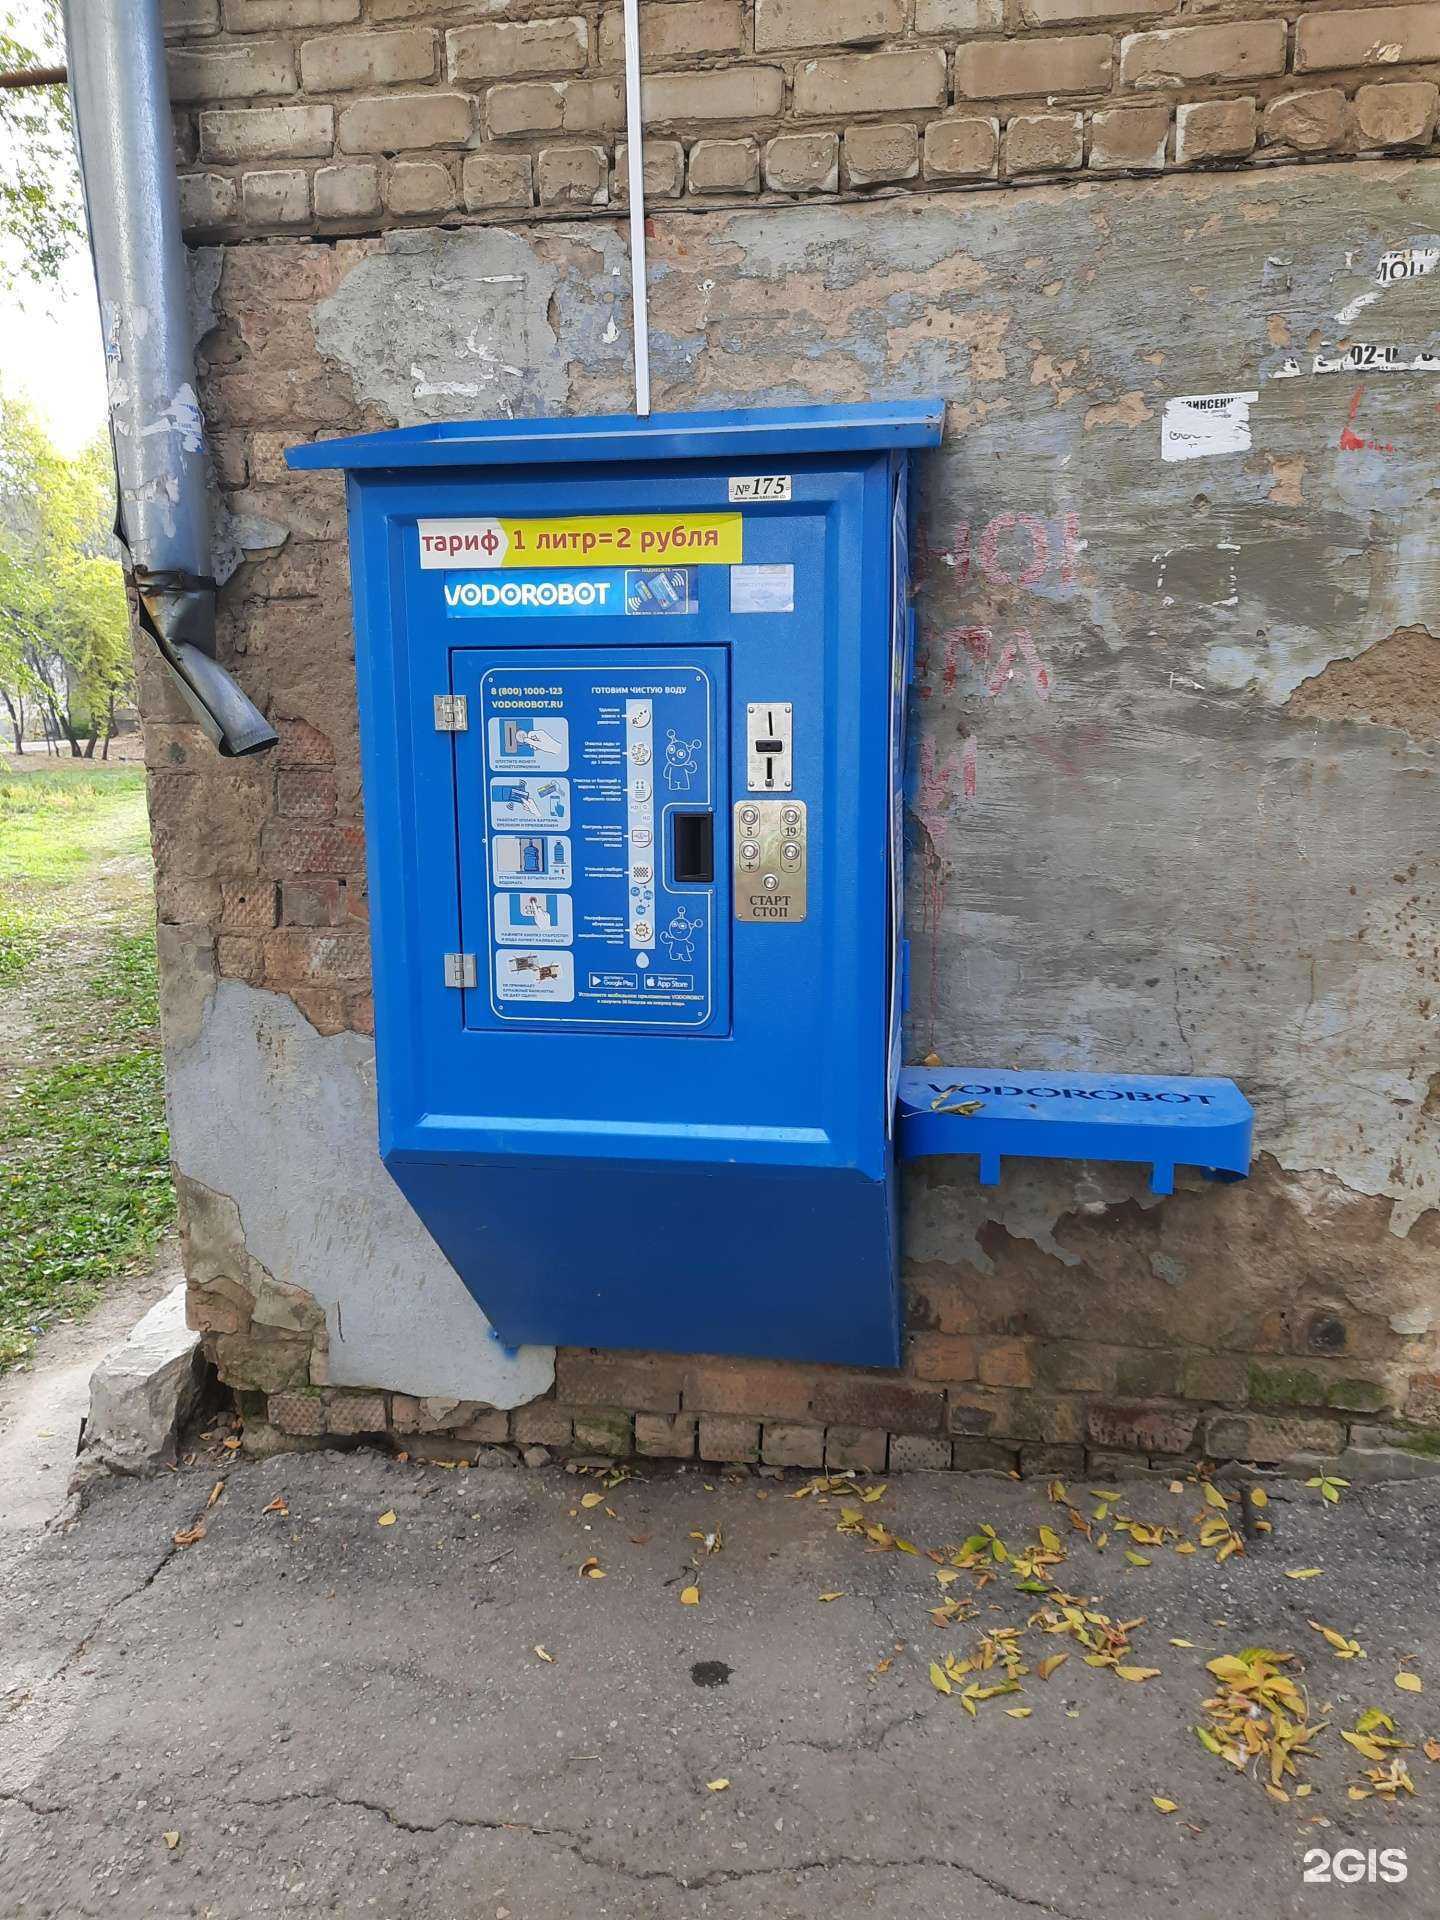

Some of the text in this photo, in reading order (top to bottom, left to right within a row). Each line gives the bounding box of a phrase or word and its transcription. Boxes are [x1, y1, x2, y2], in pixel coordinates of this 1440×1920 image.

[752, 476, 786, 495] 175
[422, 525, 719, 556] тариф 1 литр=2 рубля
[443, 582, 611, 606] VODOROBOT
[591, 686, 687, 695] ГОТОВИМ ЧИСТУЮ ВОДУ
[491, 700, 564, 709] VODOROBOT.RU
[746, 826, 753, 837] 5
[785, 826, 797, 837] 19
[749, 895, 791, 906] СТАРТ
[753, 906, 788, 917] СТОП
[927, 1083, 1216, 1105] VODOROBOT
